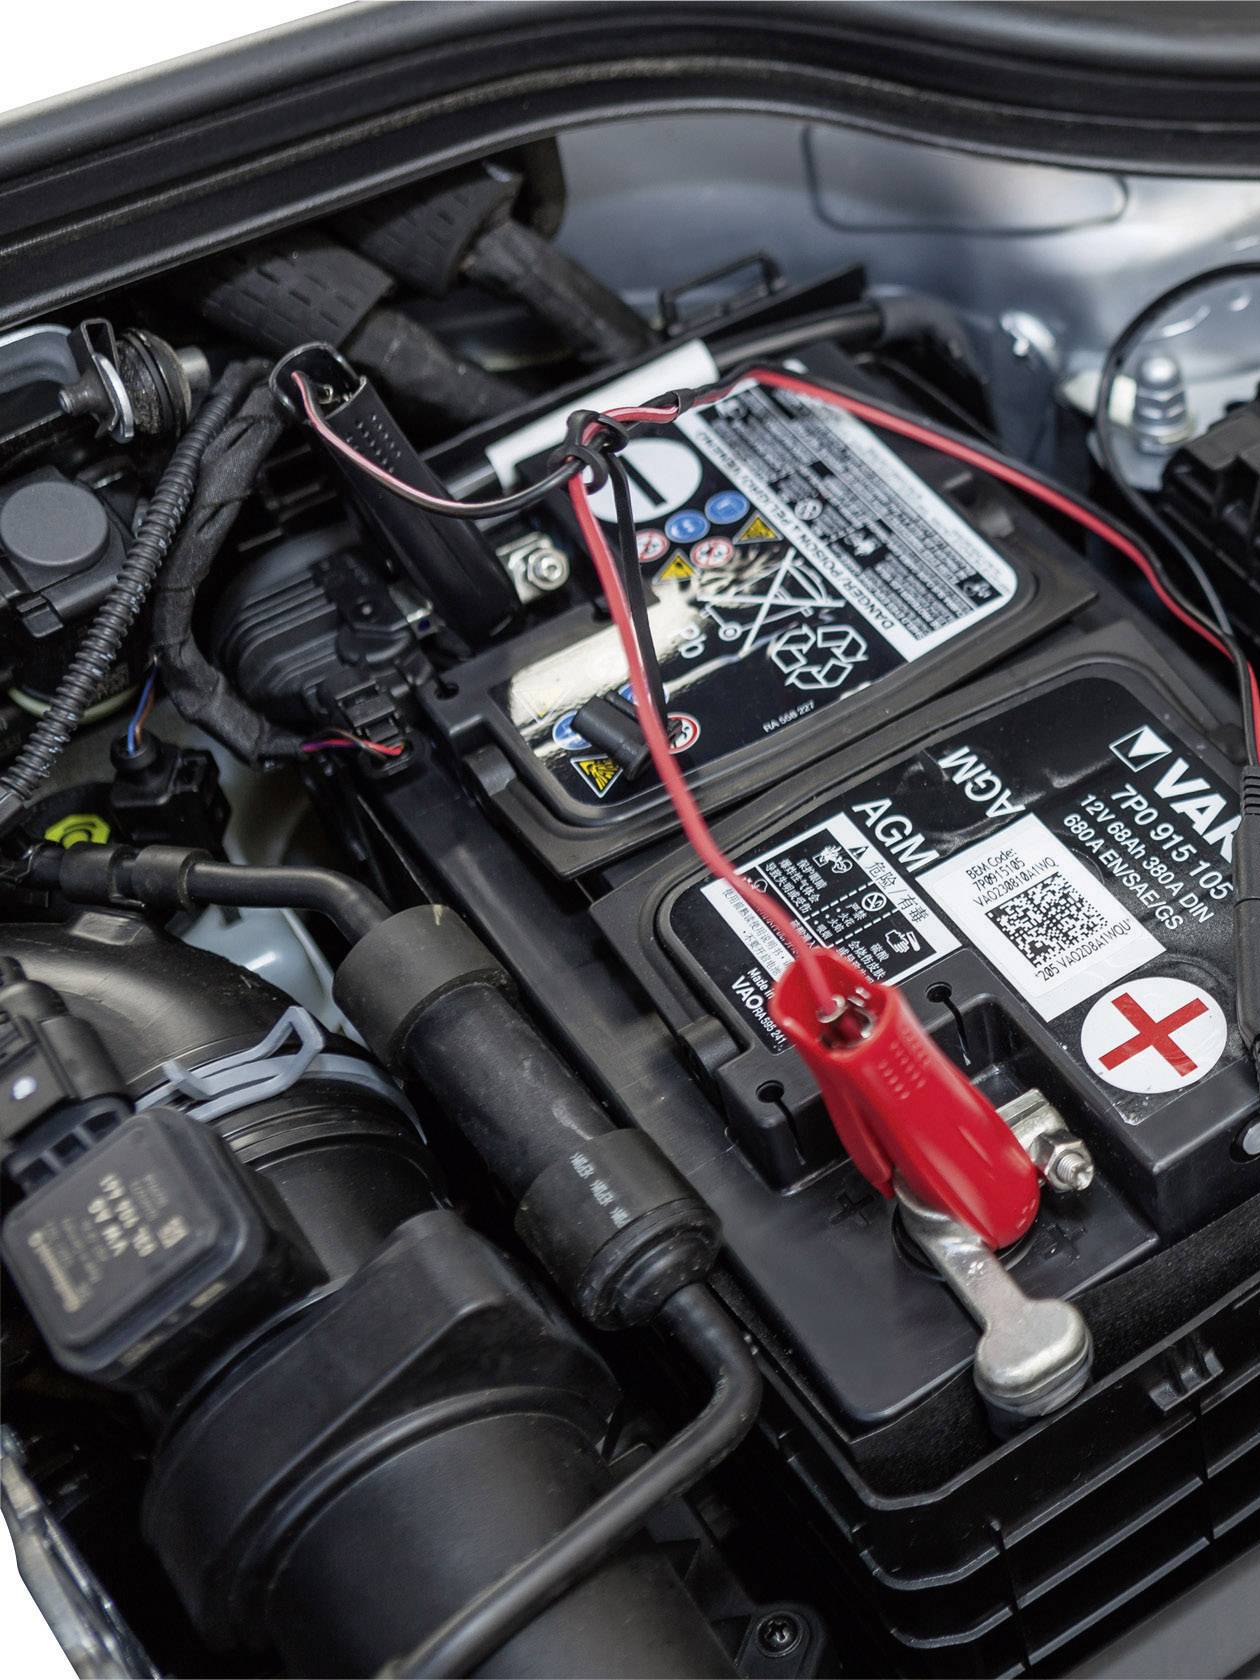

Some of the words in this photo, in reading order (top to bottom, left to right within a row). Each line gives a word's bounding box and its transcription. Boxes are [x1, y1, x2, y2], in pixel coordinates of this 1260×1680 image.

[937, 745, 1026, 819] AGM
[851, 797, 940, 873] AGM
[966, 857, 991, 880] BEM
[987, 848, 1016, 868] Code:
[1080, 794, 1116, 823] 12V
[1107, 821, 1146, 860] 68Ah
[1179, 892, 1215, 924] DIN
[1111, 783, 1158, 825] 7P0
[1150, 823, 1197, 862] 915
[1189, 860, 1234, 900] 105
[1099, 850, 1184, 930] EN/SAE/GS
[731, 975, 764, 1010] VAO
[747, 967, 769, 991] Made
[763, 988, 775, 1000] in
[101, 1223, 130, 1258] VW
